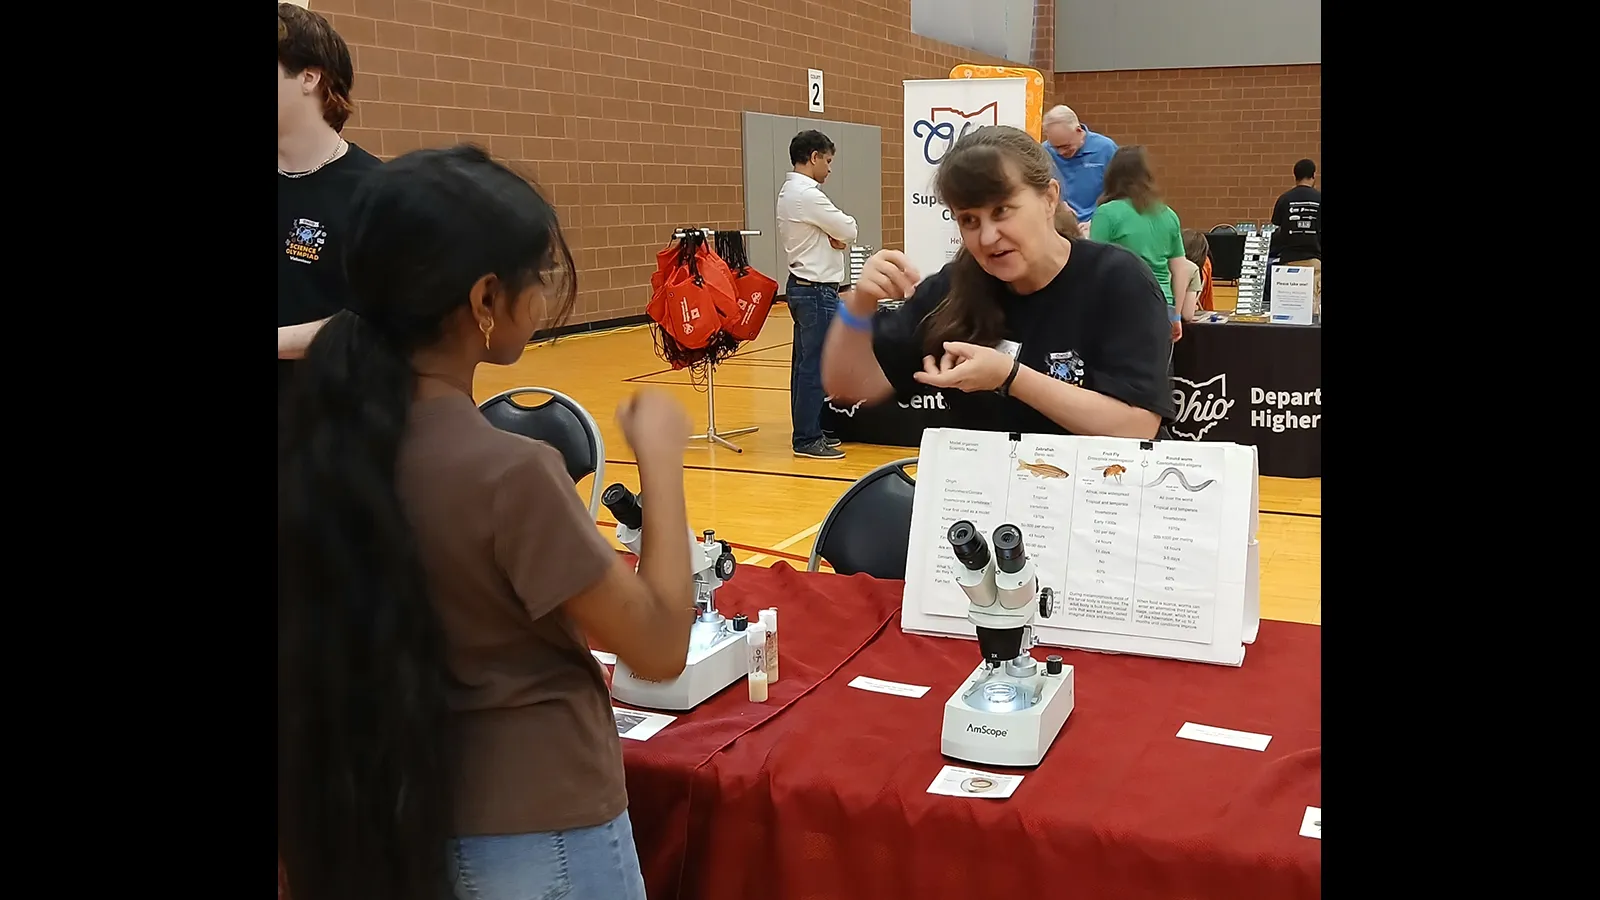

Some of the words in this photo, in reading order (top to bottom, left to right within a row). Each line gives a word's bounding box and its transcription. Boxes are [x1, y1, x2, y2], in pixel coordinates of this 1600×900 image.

[813, 83, 820, 105] 2
[286, 248, 319, 260] OLYMPIAD
[290, 243, 316, 254] SCIENCE
[1251, 387, 1321, 409] Depart
[1251, 409, 1321, 432] Higher
[966, 723, 1007, 738] AmScope
